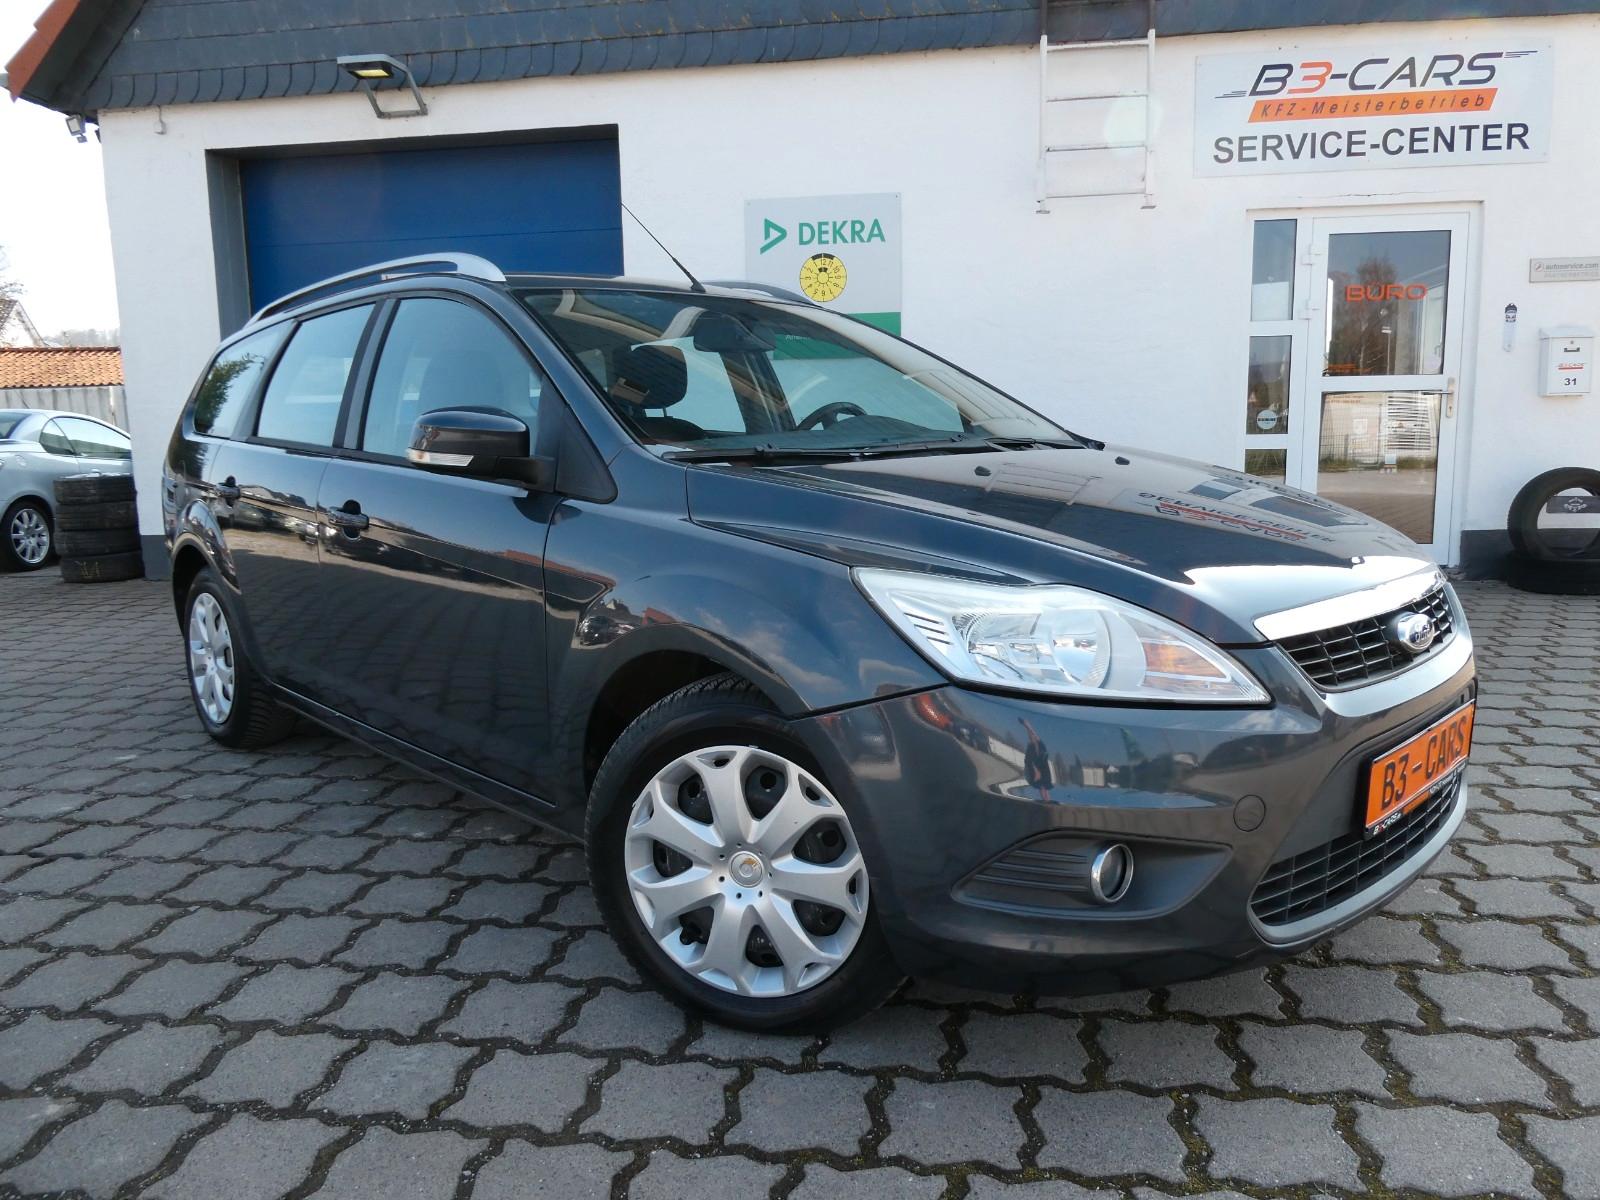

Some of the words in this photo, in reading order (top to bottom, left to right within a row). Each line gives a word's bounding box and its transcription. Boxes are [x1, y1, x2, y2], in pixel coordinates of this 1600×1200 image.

[1249, 51, 1504, 96] B3-CARS
[1213, 122, 1530, 164] SERVICE-CENTER
[798, 218, 886, 246] DEKRA
[1564, 377, 1577, 386] 31
[1381, 715, 1468, 811] B3-CARS
